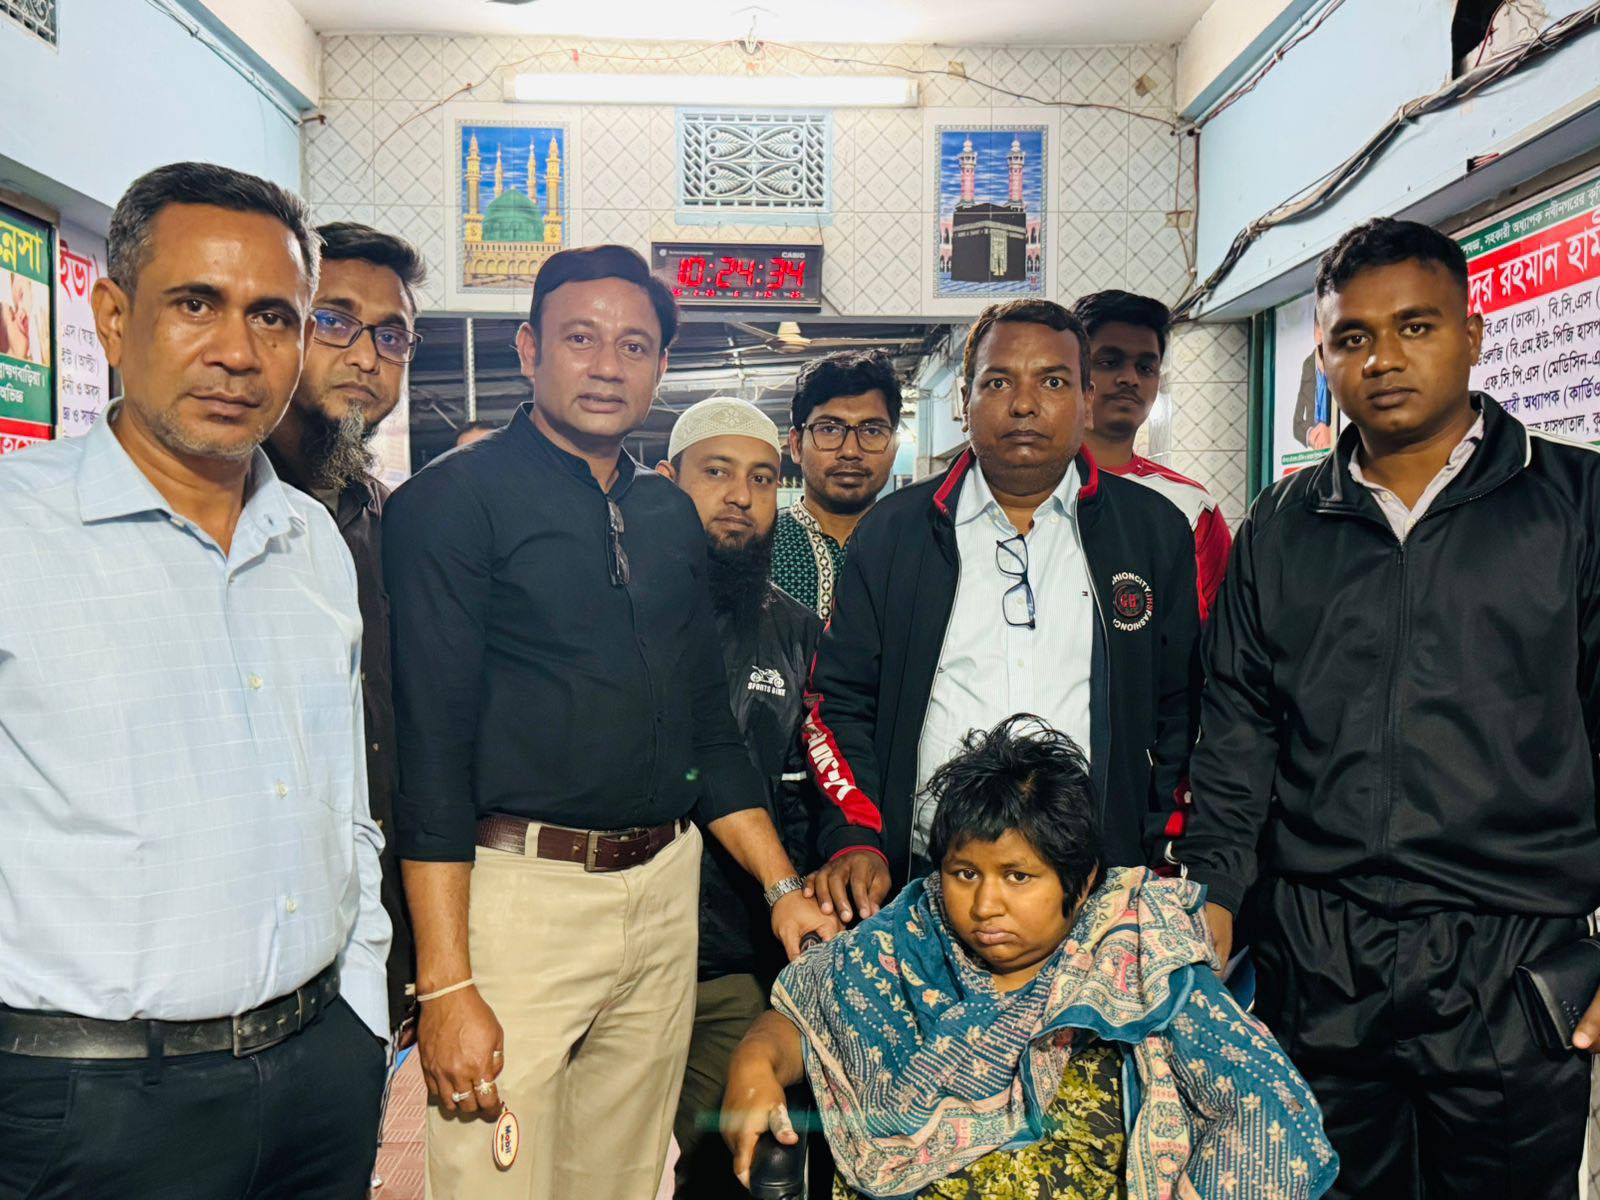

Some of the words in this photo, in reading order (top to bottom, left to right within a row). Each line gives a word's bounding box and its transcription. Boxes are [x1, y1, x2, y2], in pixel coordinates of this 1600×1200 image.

[781, 251, 806, 259] CASIO
[677, 256, 806, 289] 10:24:34
[1467, 268, 1495, 314] দুর
[1498, 241, 1561, 296] রহমান
[1483, 317, 1509, 339] বি.এস
[1511, 305, 1545, 335] (ঢাকা),
[1548, 291, 1592, 321] বি.সি.এস
[1577, 319, 1600, 341] হাসপ
[1500, 392, 1521, 414] কারী
[1523, 390, 1560, 411] অধ্যাপক
[1563, 375, 1600, 409] (কার্ডিও
[747, 681, 771, 693] SPORTS
